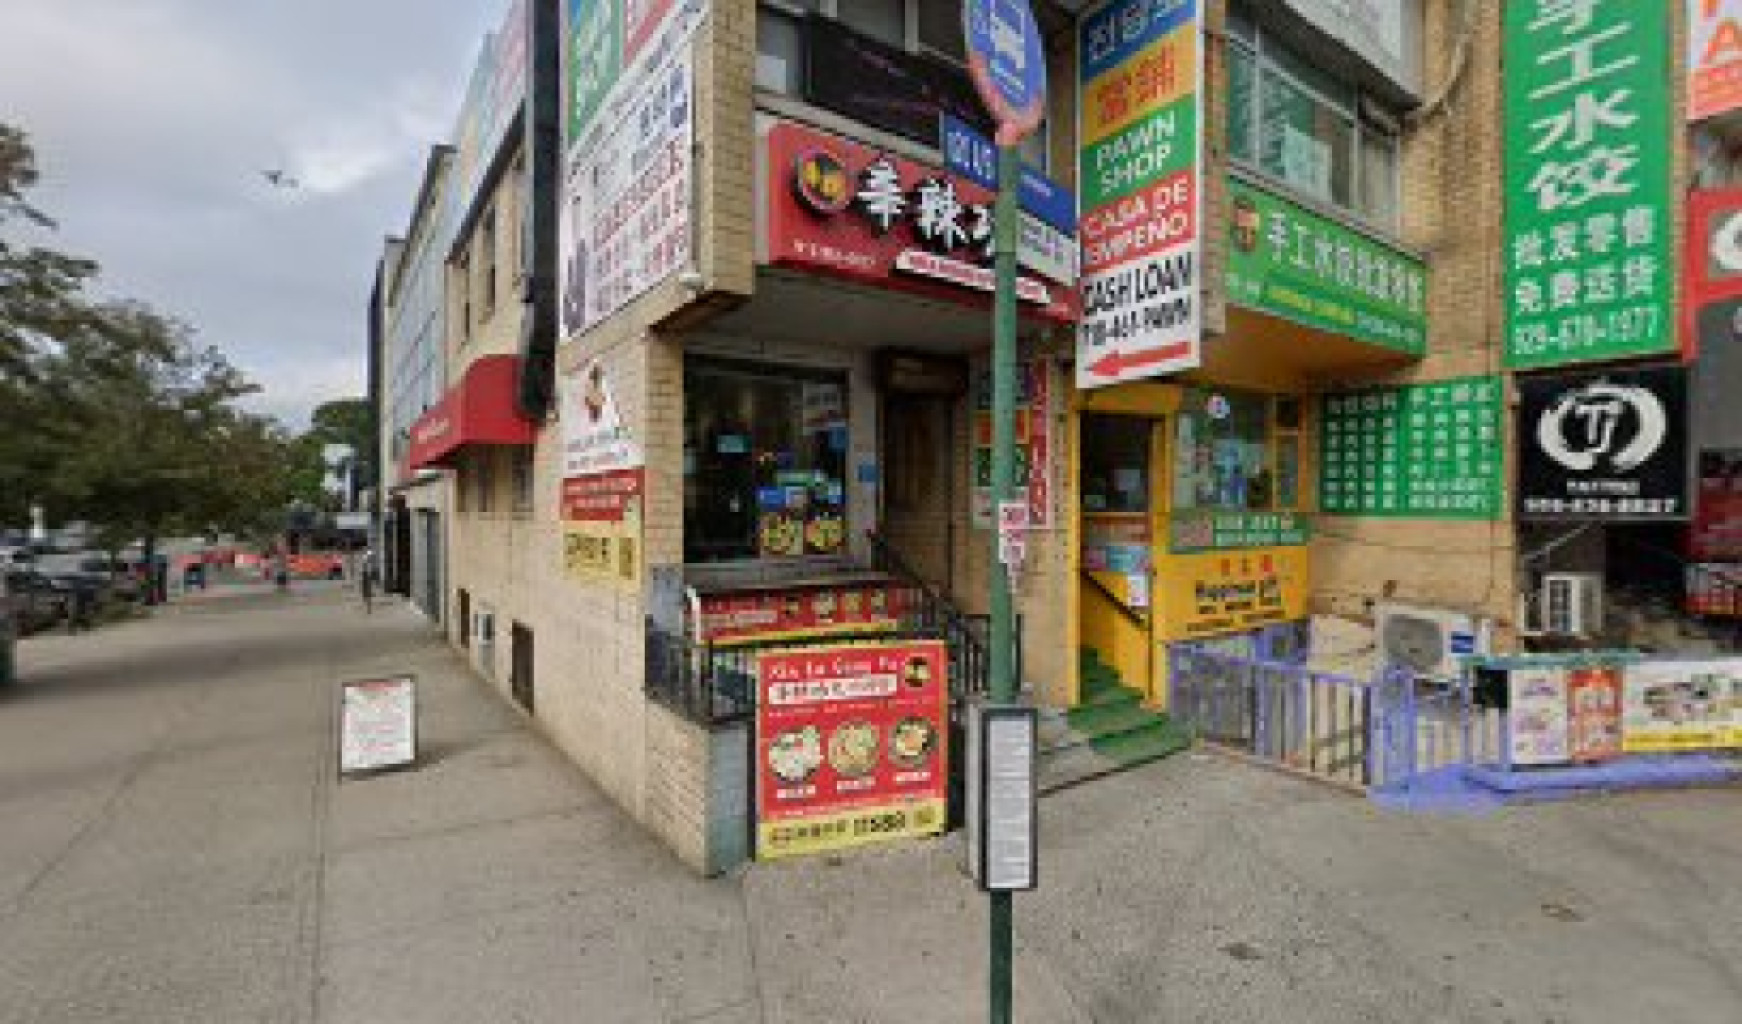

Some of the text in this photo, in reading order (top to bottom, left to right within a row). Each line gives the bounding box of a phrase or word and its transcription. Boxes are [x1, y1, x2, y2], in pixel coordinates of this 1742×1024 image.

[1096, 109, 1175, 171] PAWN
[1100, 141, 1171, 197] SHOP
[1082, 181, 1189, 237] CASA DE
[1511, 204, 1658, 271] 批发零售
[1081, 267, 1133, 318] CASH
[1135, 251, 1192, 305] LOAN
[1514, 254, 1658, 316] 免费送货
